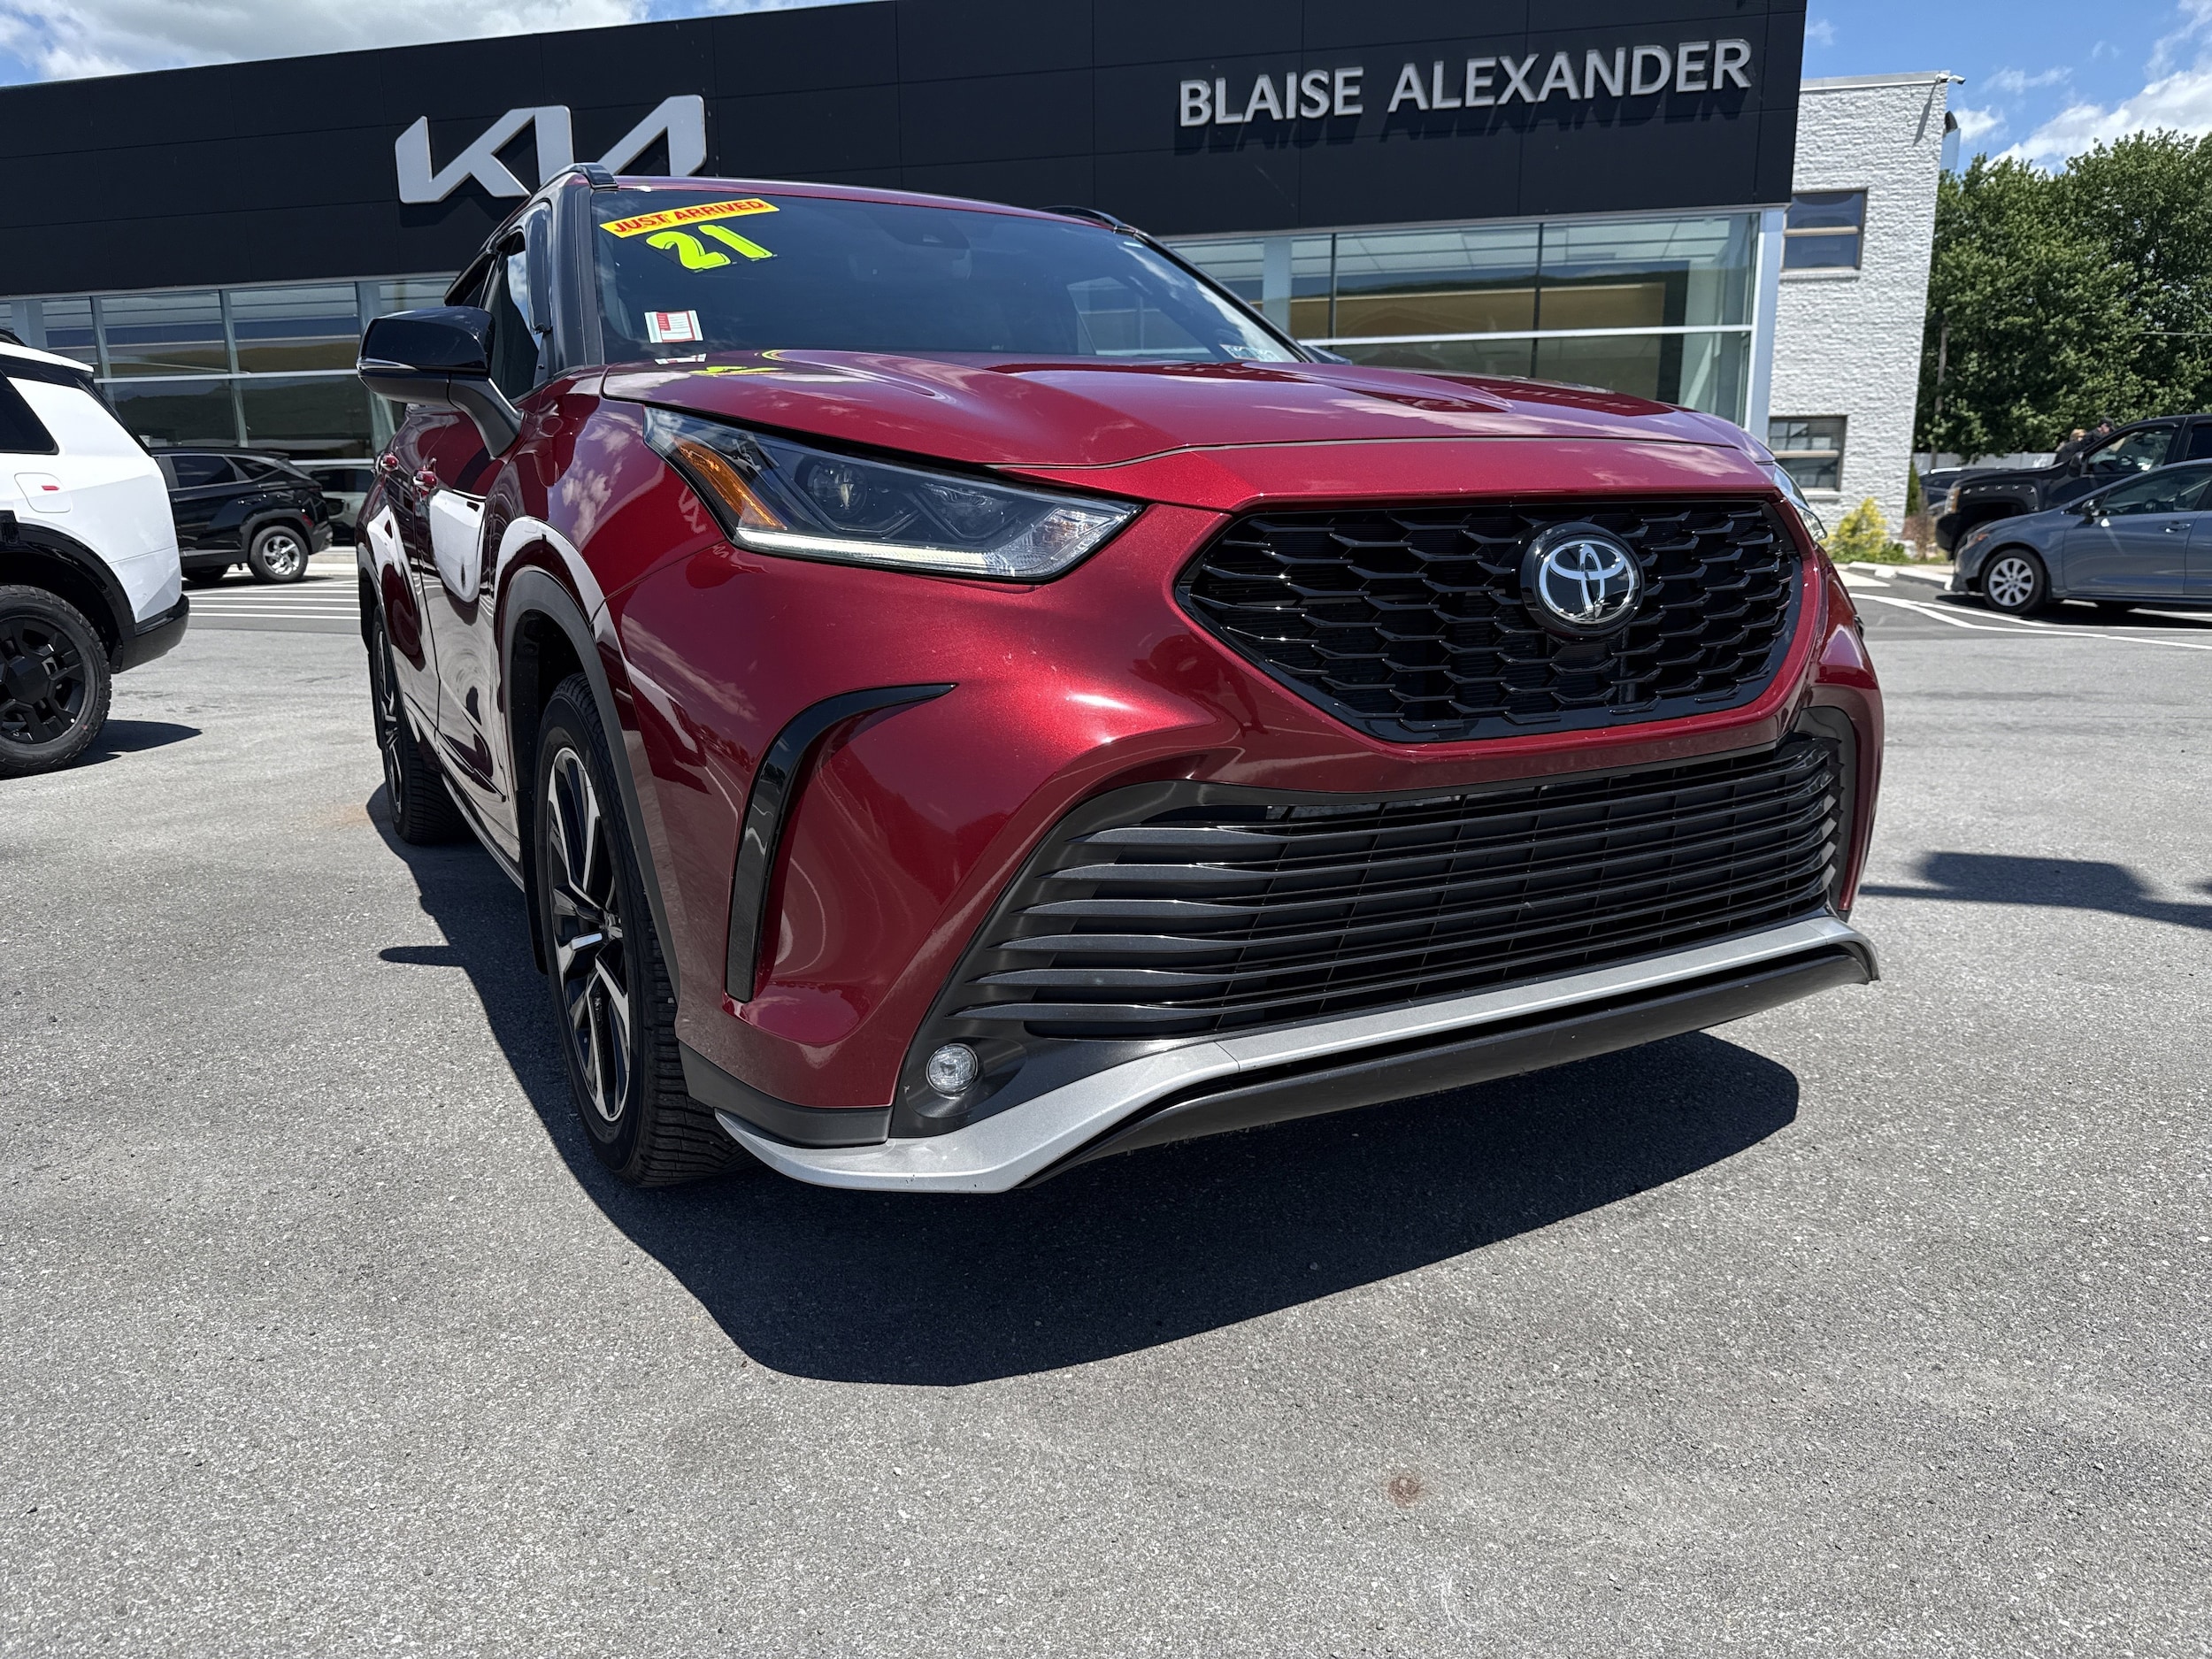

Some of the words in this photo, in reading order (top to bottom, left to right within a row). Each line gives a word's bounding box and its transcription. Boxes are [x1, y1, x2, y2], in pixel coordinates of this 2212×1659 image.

[1179, 66, 1364, 127] BLAISE
[1387, 38, 1751, 113] ALEXANDER
[396, 95, 706, 204] KIA
[614, 213, 668, 234] JUST
[675, 200, 766, 220] ARRIVED
[646, 224, 774, 270] 21
